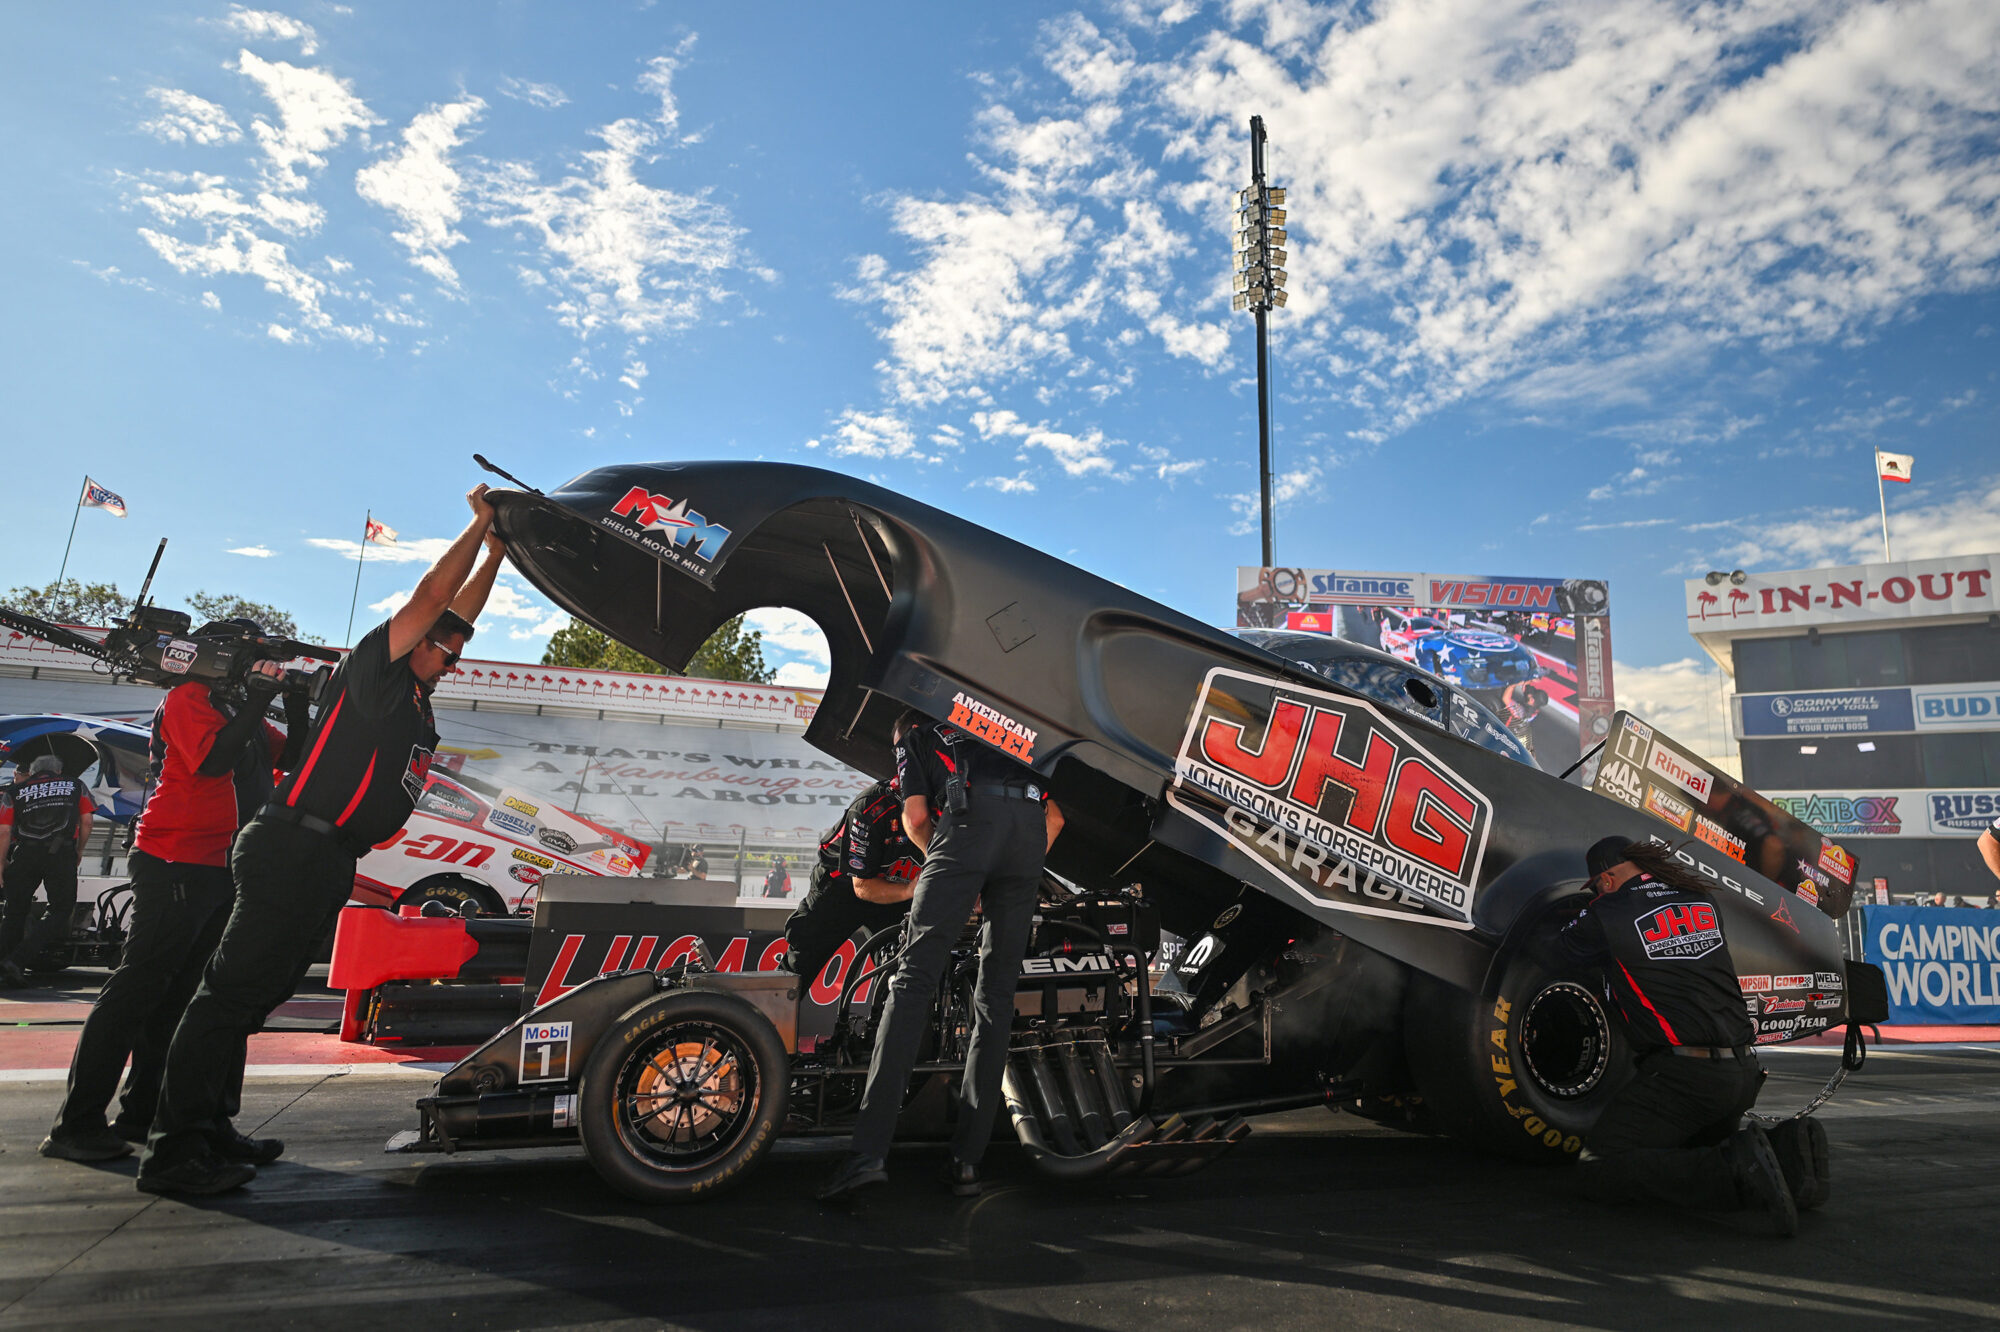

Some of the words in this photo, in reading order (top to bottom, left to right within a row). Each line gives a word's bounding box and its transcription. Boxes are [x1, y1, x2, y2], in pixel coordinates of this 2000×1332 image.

[601, 517, 641, 541] SHELOR
[640, 536, 680, 562] MOTOR
[681, 558, 707, 577] MILE
[1311, 572, 1410, 597] Strange
[1431, 581, 1553, 607] VISION
[1758, 568, 1991, 614] IN-N-OUT
[168, 648, 192, 661] FOX
[1586, 617, 1604, 697] Strange
[1793, 705, 1838, 713] QUALITY
[1794, 696, 1877, 707] CORNWELL
[1924, 696, 1991, 718] BUD
[952, 692, 1037, 743] AMERICAN
[1625, 717, 1651, 740] Mobil
[1787, 724, 1798, 732] BE
[1799, 724, 1821, 732] YOUR
[1824, 723, 1844, 731] OWN
[1846, 721, 1868, 730] BOSS
[947, 701, 1034, 765] REBEL
[528, 742, 711, 763] THAT'S
[1627, 735, 1638, 759] 1
[521, 761, 562, 774] A
[1655, 750, 1707, 795] Rinnai
[19, 780, 74, 796] MAKERS
[1200, 696, 1478, 879] JHG
[1600, 760, 1642, 800] MAC
[24, 787, 72, 803] FIXERS
[552, 780, 659, 797] ALL
[672, 786, 850, 806] ABOUT
[1598, 776, 1640, 809] TOOLS
[1651, 788, 1690, 817] RUSH
[490, 809, 536, 834] RUSSELLS
[1695, 814, 1747, 850] AMERICAN
[1836, 825, 1864, 834] PARTY
[1866, 825, 1901, 834] PUNCH
[1182, 763, 1300, 830] JOHNSON'S
[1304, 817, 1465, 908] HORSEPOWERED
[1693, 822, 1746, 865] REBEL
[519, 849, 554, 868] KICKER
[1223, 805, 1425, 909] GARAGE
[1805, 865, 1814, 878] ALL
[1816, 871, 1830, 888] STAR
[1643, 905, 1717, 942] JHG
[1663, 939, 1715, 956] GARAGE
[1020, 955, 1111, 974] EMI
[1738, 977, 1769, 991] MPSON
[1776, 976, 1805, 987] COMP
[1816, 973, 1842, 983] WELD
[525, 1025, 569, 1041] Mobil
[623, 1009, 667, 1044] EAGLE
[537, 1044, 551, 1077] 1
